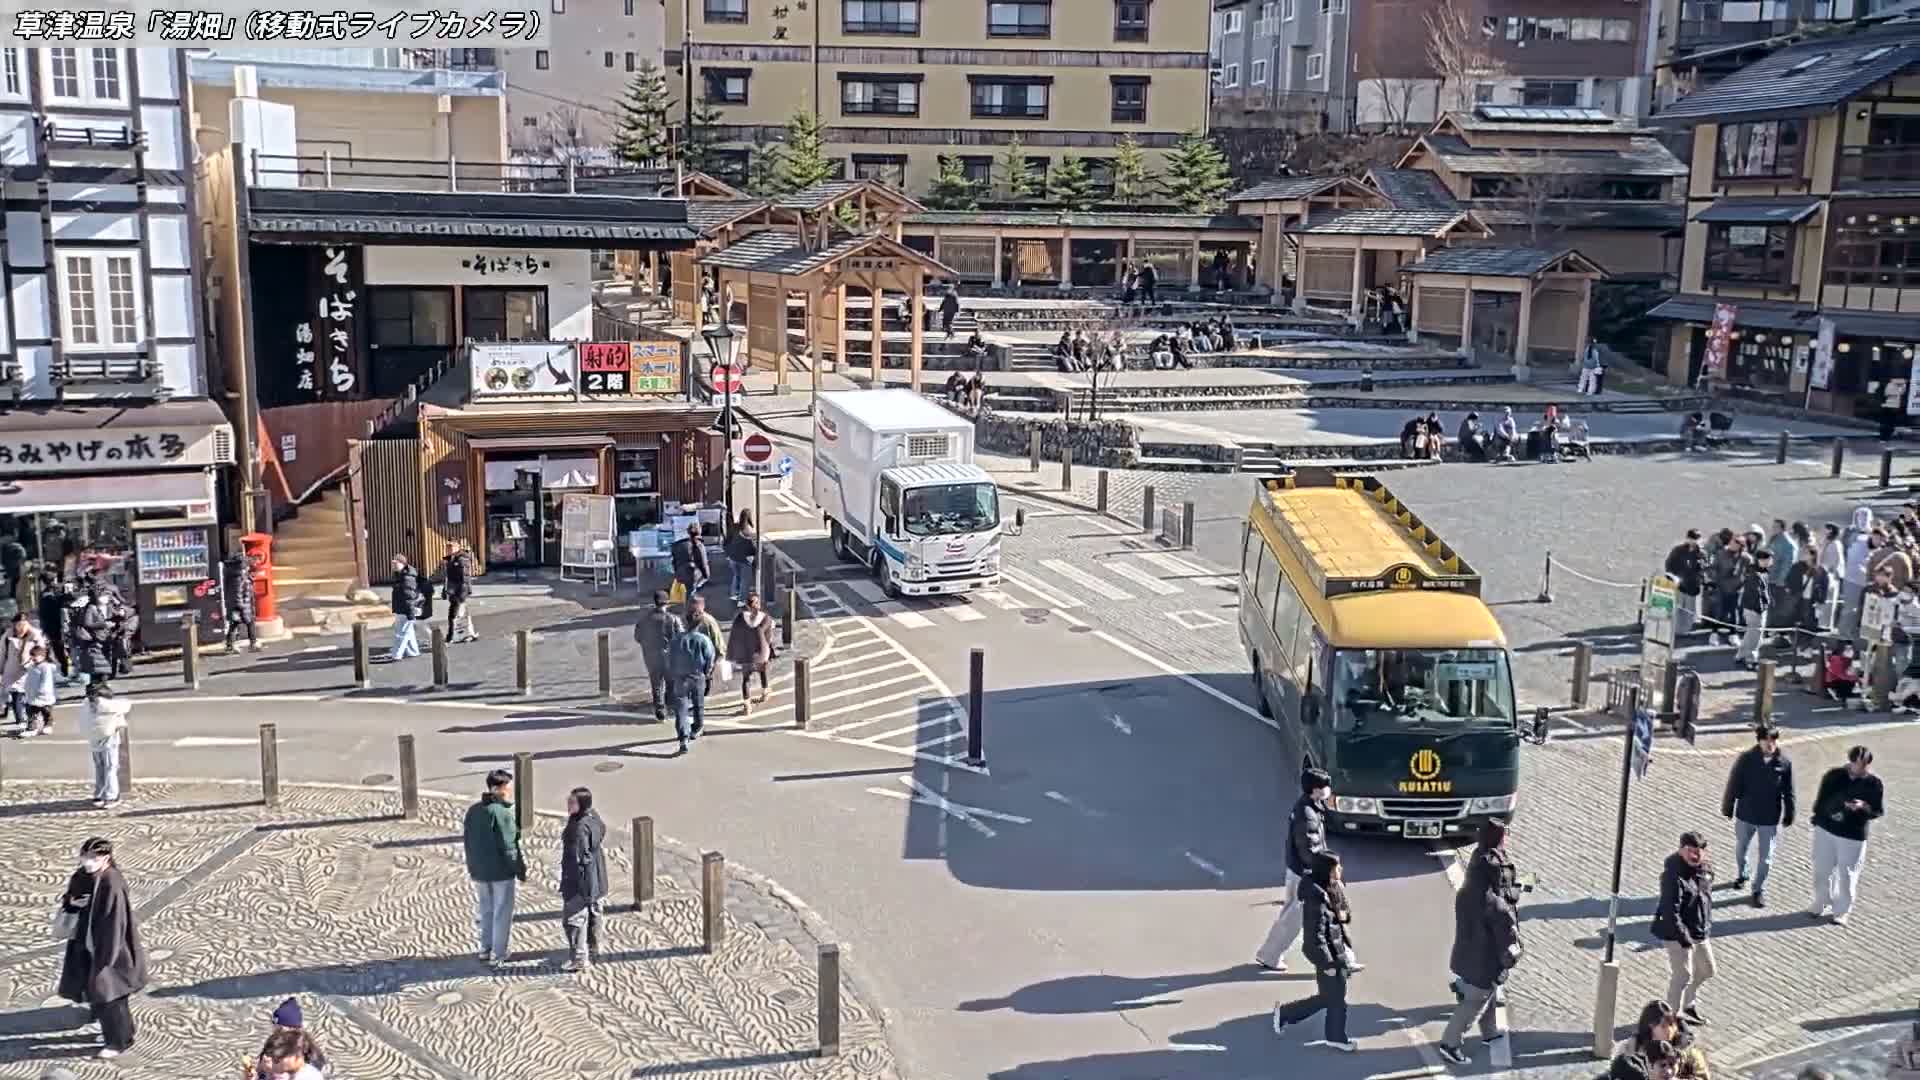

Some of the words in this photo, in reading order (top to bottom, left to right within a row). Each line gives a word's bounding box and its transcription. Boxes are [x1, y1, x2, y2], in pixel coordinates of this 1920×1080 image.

[584, 345, 628, 368] 射的
[641, 362, 678, 375] ホール
[588, 373, 624, 391] 2階
